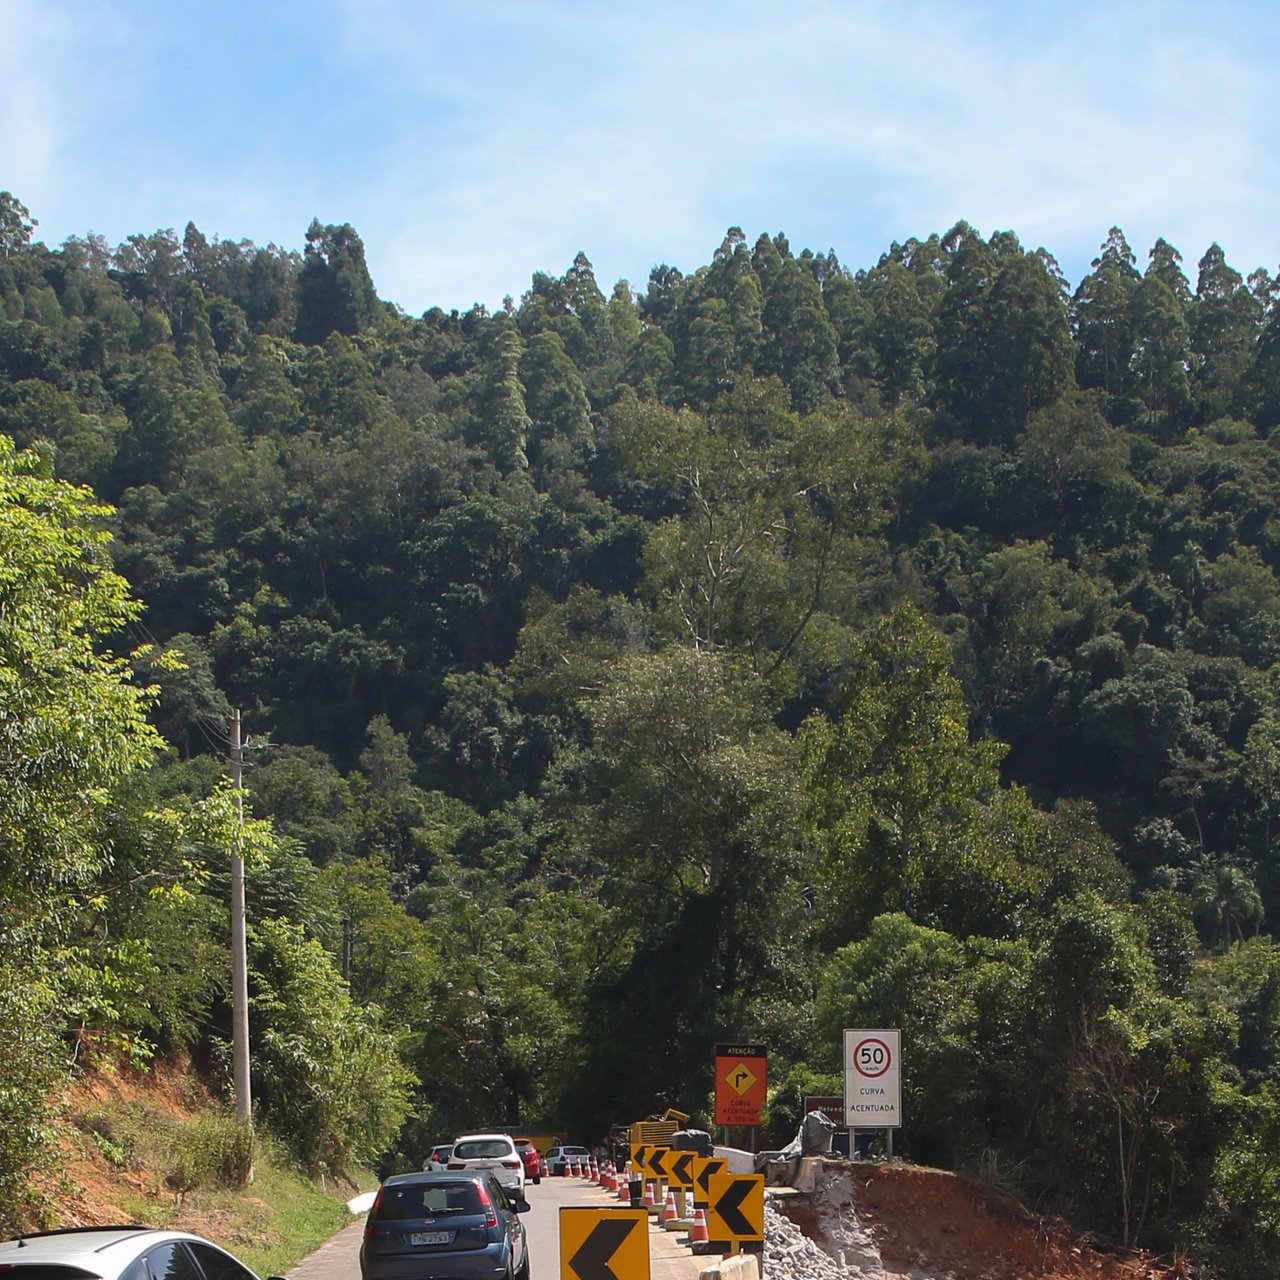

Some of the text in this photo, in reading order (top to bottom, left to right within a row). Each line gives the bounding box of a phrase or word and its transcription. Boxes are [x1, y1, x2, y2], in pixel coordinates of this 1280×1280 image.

[727, 1047, 756, 1056] ATENÇÃO
[861, 1048, 884, 1064] 50
[859, 1087, 885, 1096] CURVA
[850, 1104, 895, 1112] ACENTUADA
